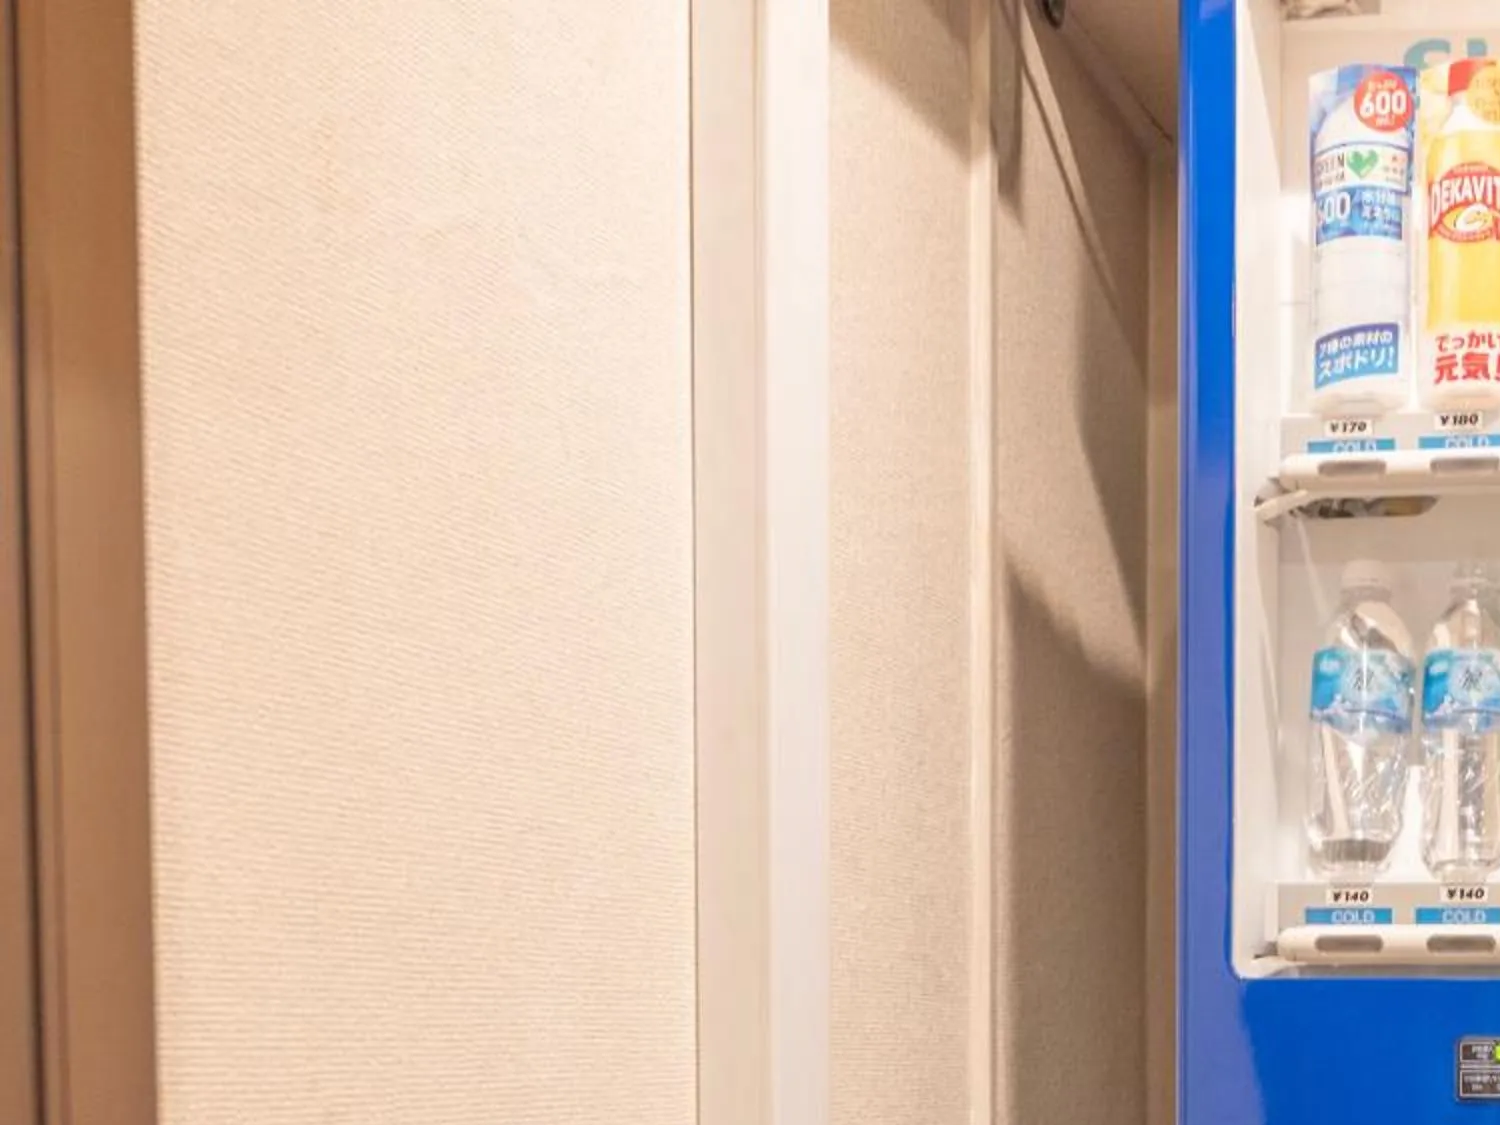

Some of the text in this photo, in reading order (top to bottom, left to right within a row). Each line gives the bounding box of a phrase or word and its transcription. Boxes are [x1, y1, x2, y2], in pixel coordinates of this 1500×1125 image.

[1359, 91, 1407, 118] 600
[1331, 910, 1375, 924] COLD
[1442, 909, 1486, 924] COLD
